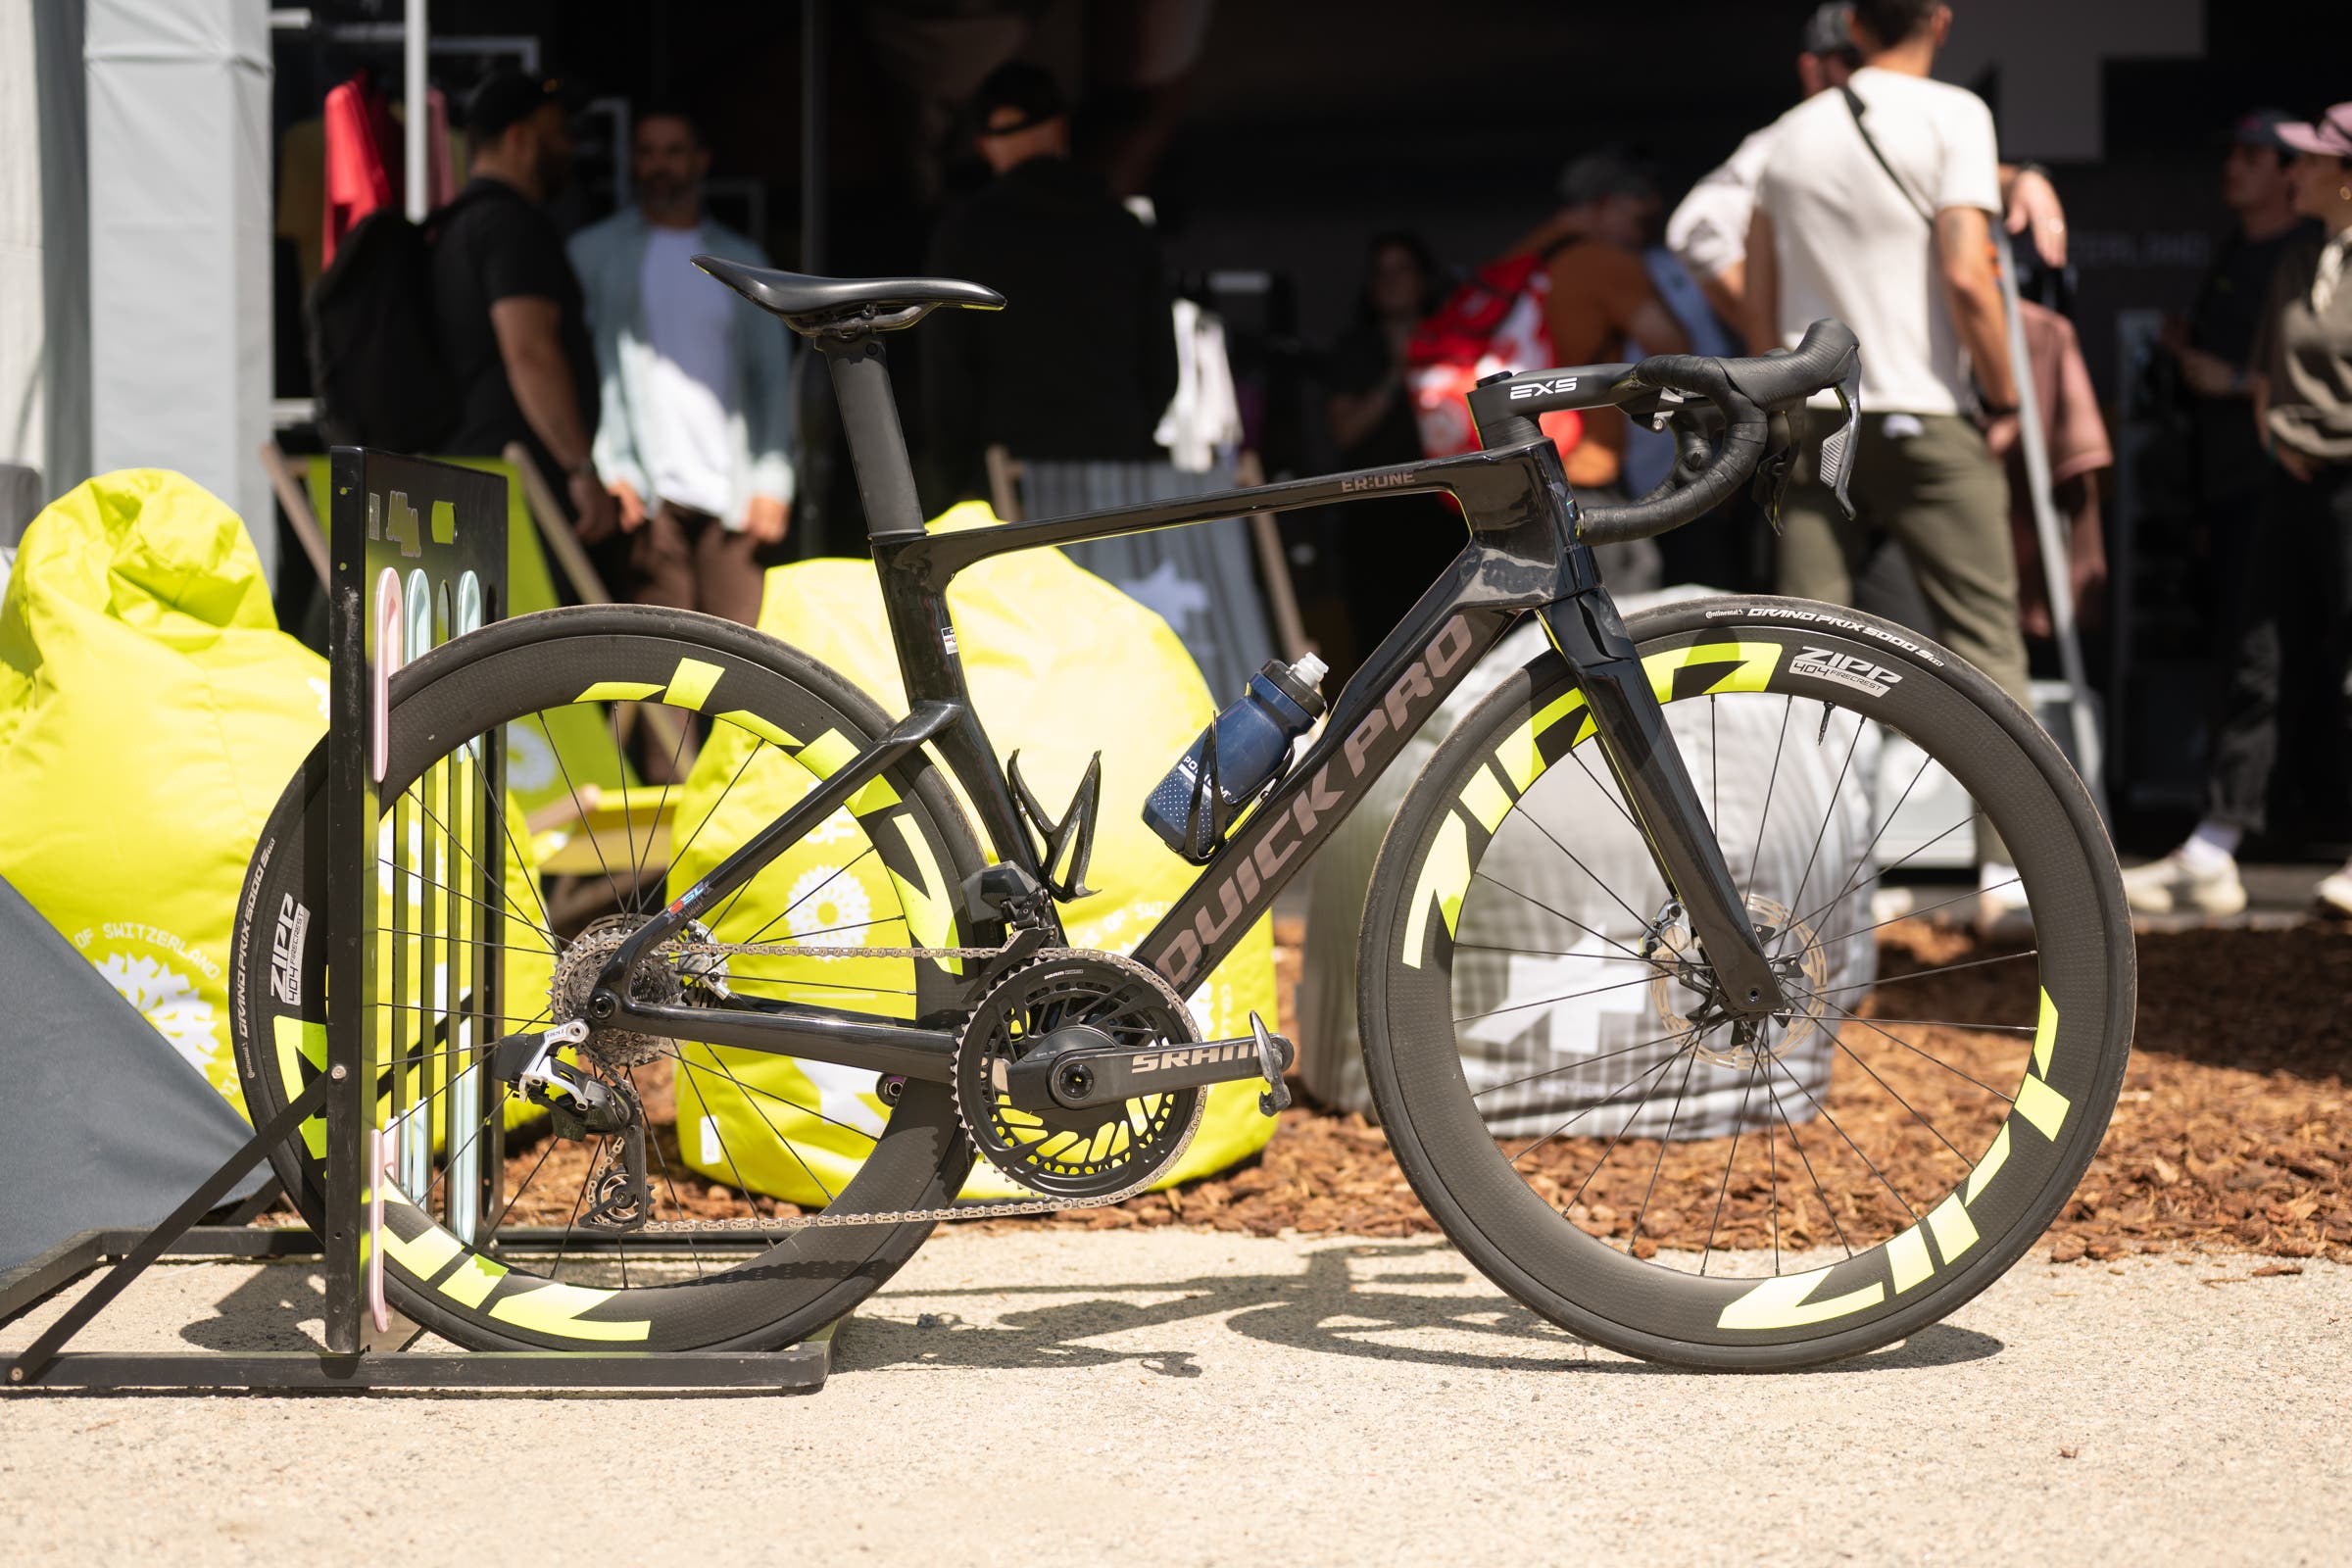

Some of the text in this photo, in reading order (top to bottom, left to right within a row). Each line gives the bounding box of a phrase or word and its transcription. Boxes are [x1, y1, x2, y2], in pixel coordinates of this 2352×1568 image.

[1510, 377, 1577, 400] EXS
[1705, 609, 1739, 619] Continental
[1746, 609, 1816, 621] GRAND
[1815, 615, 1865, 631] PRIX
[1862, 627, 1919, 652] 5000
[1915, 649, 1934, 660] S
[1793, 662, 1883, 690] 404 FIRECREST
[1794, 646, 1903, 683] ZIPP
[1155, 614, 1472, 987] QUICK PRO
[245, 864, 264, 922] 5000
[74, 922, 220, 979] OF SWITZERLAND
[238, 920, 251, 971] PRIX
[270, 893, 294, 1004] ZIPP
[288, 909, 305, 1001] 404 FIRECREST
[237, 973, 249, 1038] GRAND
[1131, 1043, 1258, 1074] SRAM
